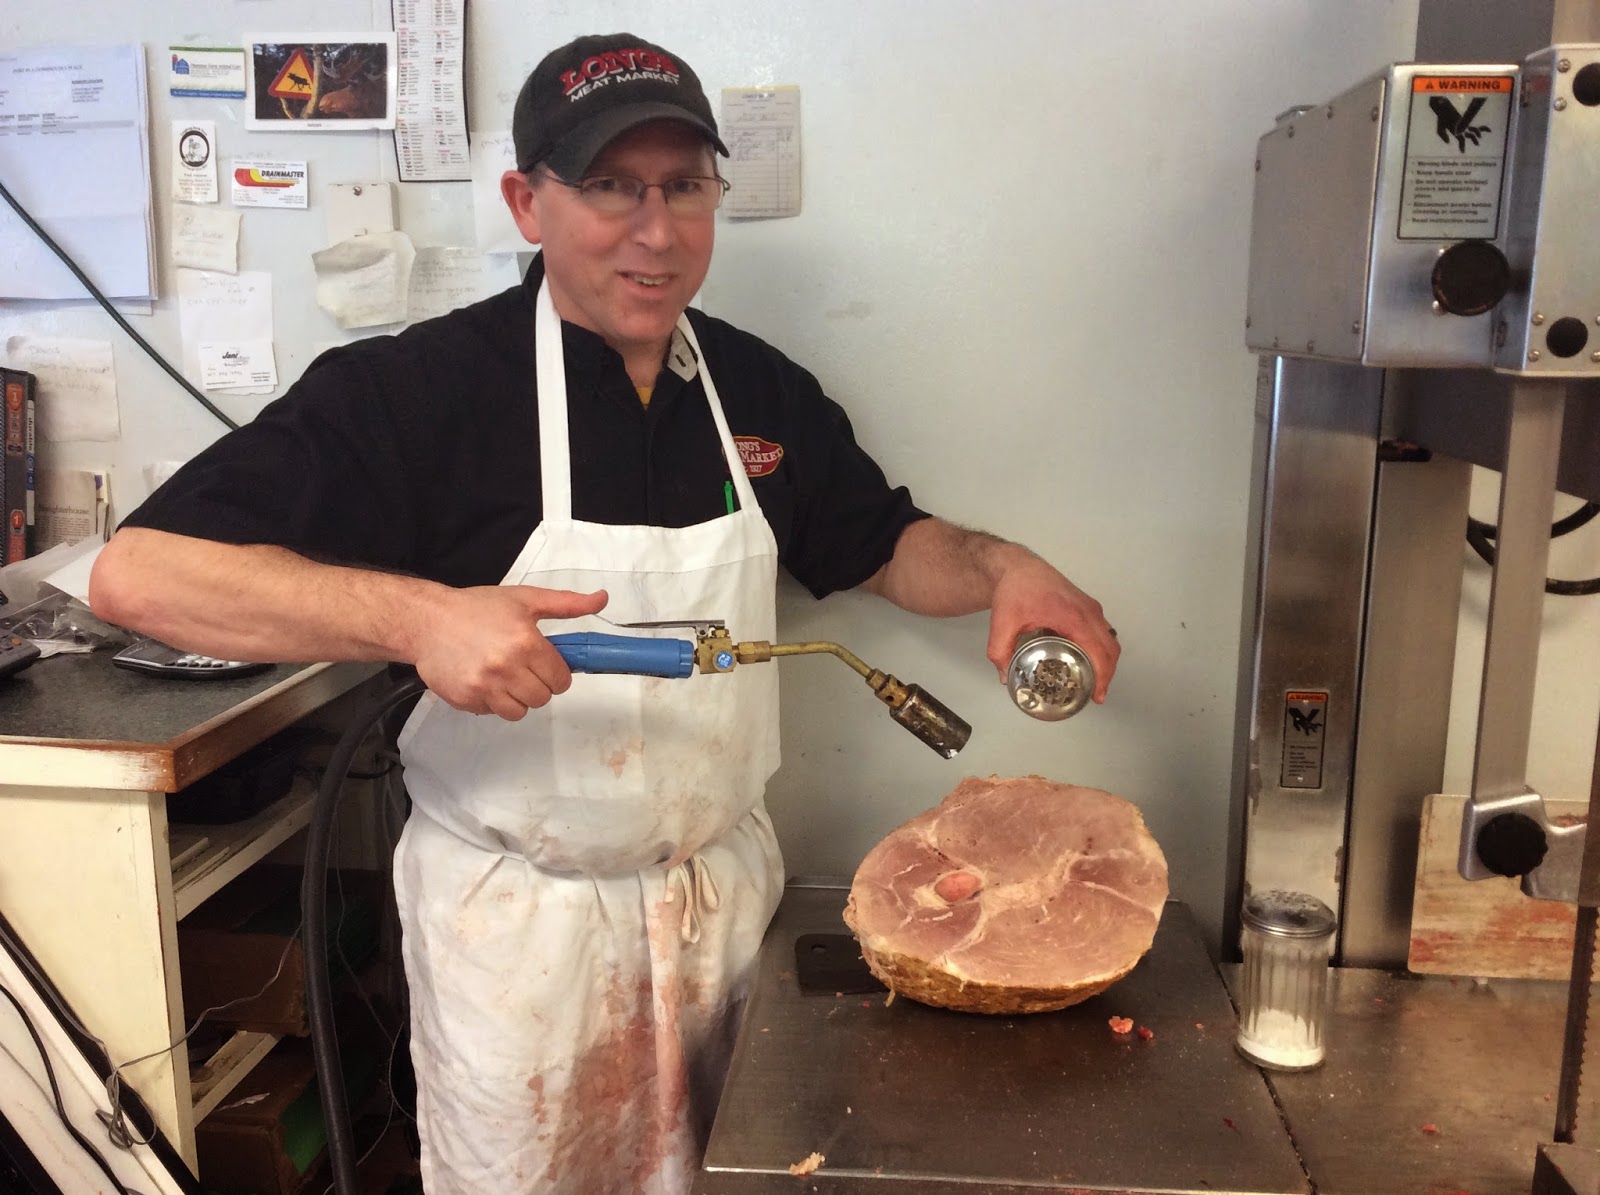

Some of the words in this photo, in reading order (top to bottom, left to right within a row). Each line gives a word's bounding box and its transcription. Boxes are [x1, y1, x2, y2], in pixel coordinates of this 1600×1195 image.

[570, 77, 612, 102] MEAT
[616, 71, 680, 85] MARKET
[1438, 79, 1501, 90] WARNING
[261, 170, 305, 179] DRAINMASTER
[735, 441, 761, 451] ONG'S
[740, 447, 782, 463] MARKET
